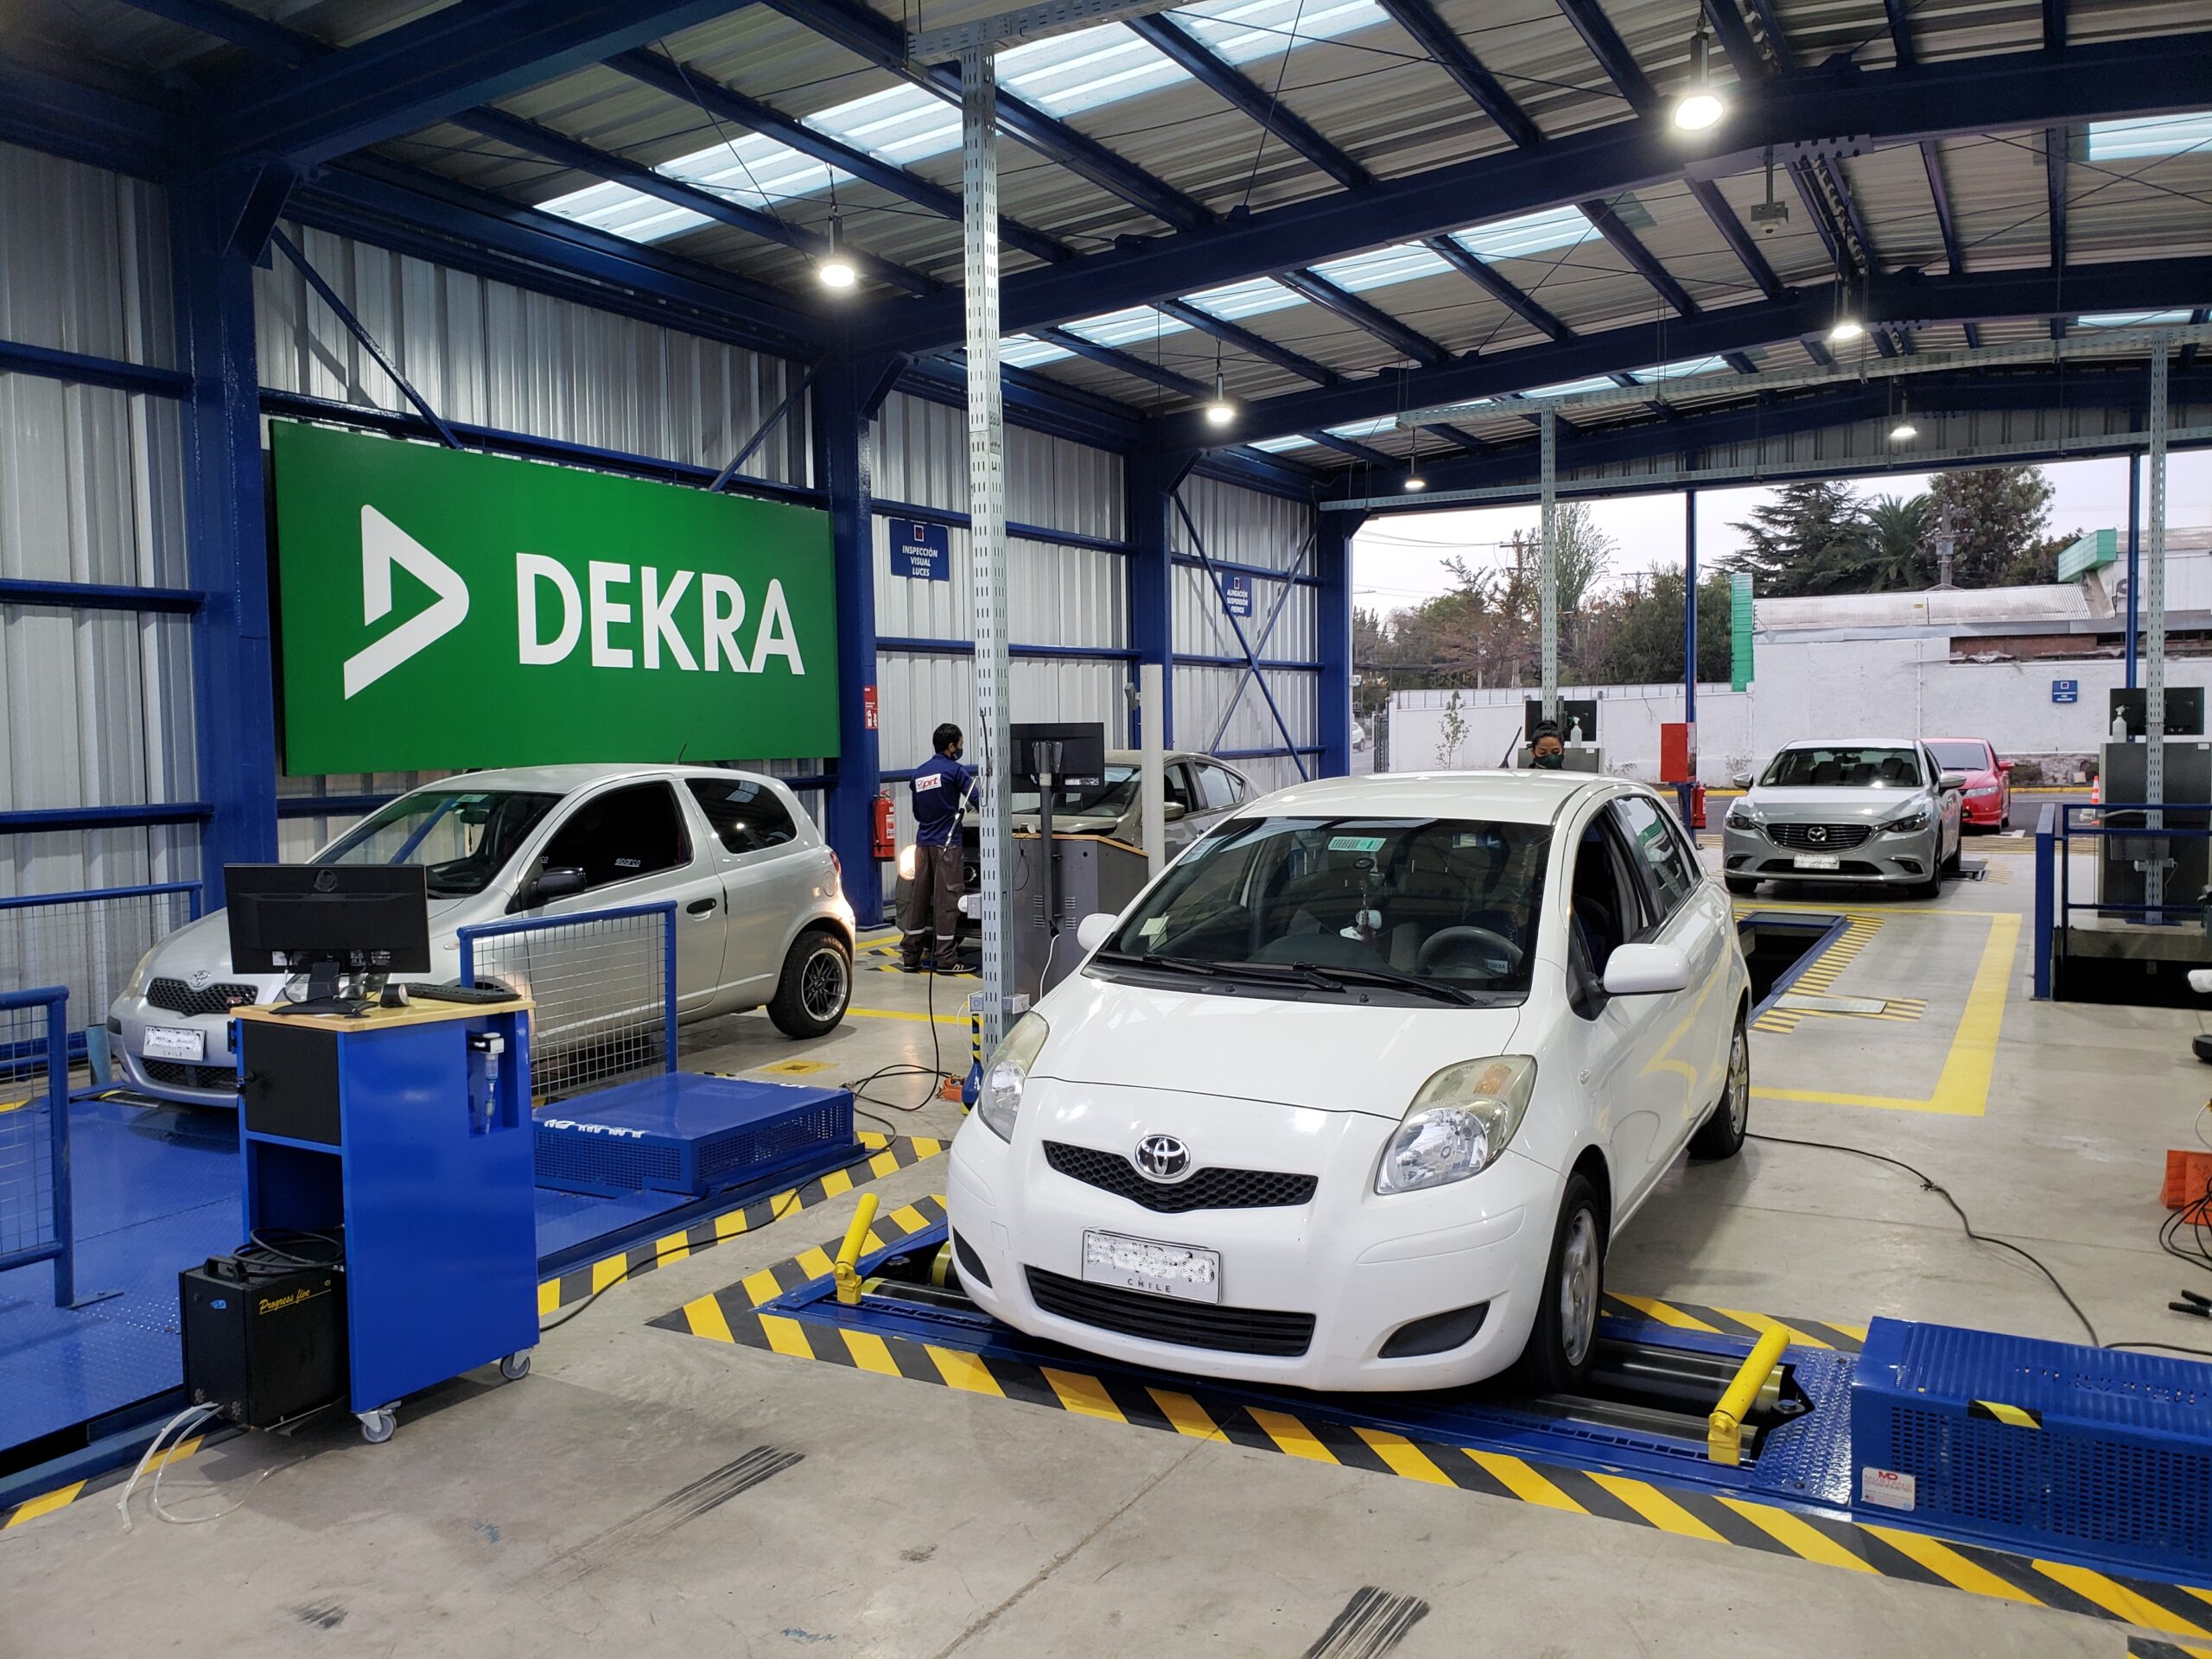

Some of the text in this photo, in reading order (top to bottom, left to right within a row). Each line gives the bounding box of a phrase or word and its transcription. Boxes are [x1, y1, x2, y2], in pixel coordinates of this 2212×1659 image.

[902, 545, 938, 558] INSPECCIÓN
[910, 556, 931, 567] VISUAL
[912, 567, 931, 577] LUCES
[516, 552, 805, 676] DEKRA
[922, 777, 938, 790] prt
[615, 858, 641, 867] sparco
[1127, 1277, 1173, 1294] CHILE
[1878, 1471, 1899, 1481] MD
